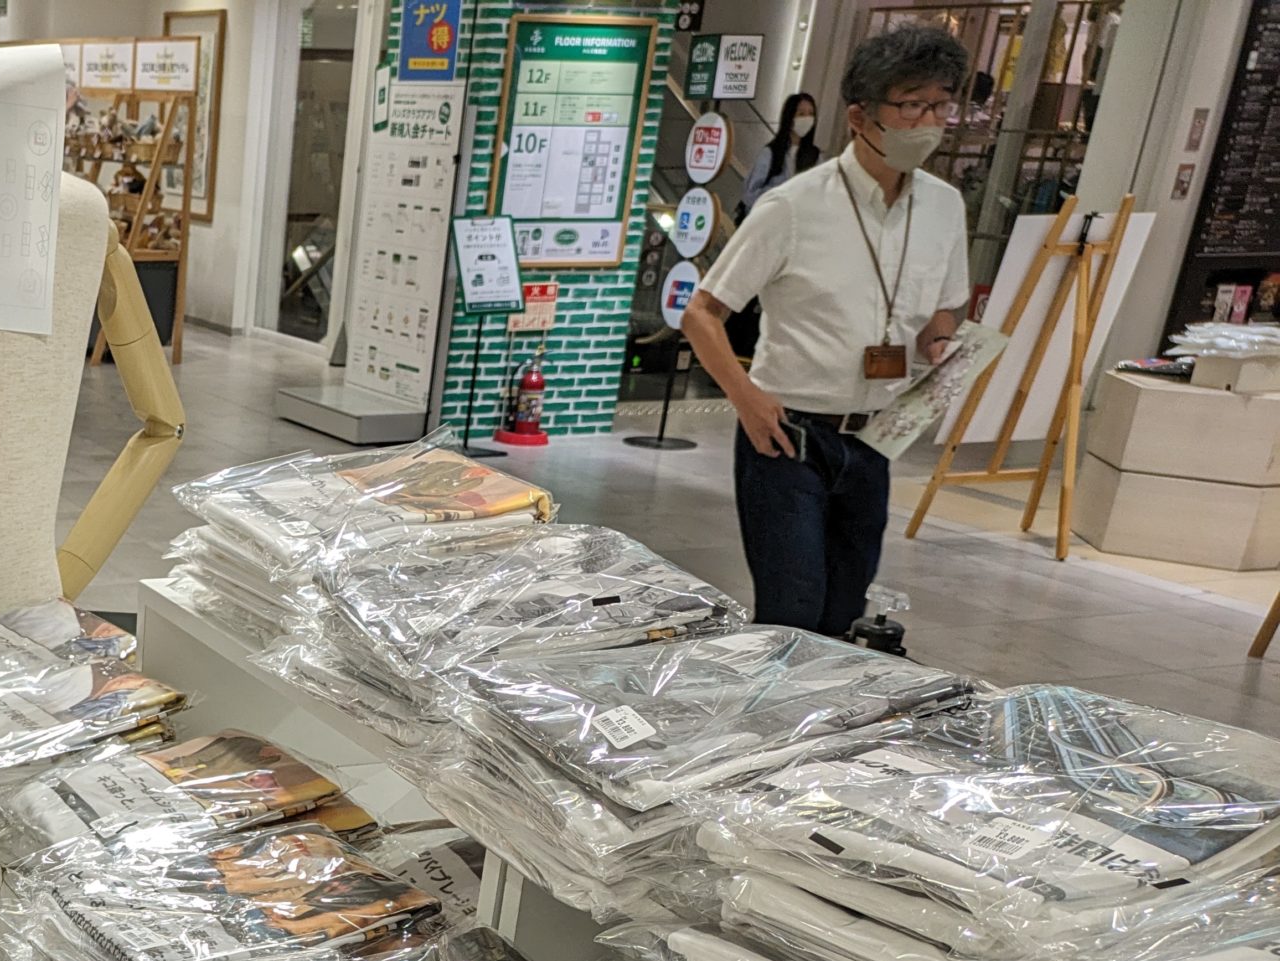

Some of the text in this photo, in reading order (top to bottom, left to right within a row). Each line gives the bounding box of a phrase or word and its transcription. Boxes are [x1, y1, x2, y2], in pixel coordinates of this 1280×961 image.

[555, 36, 637, 48] FLOOR INFORMATION
[724, 41, 758, 62] WELCOME
[724, 72, 751, 81] TOKYU
